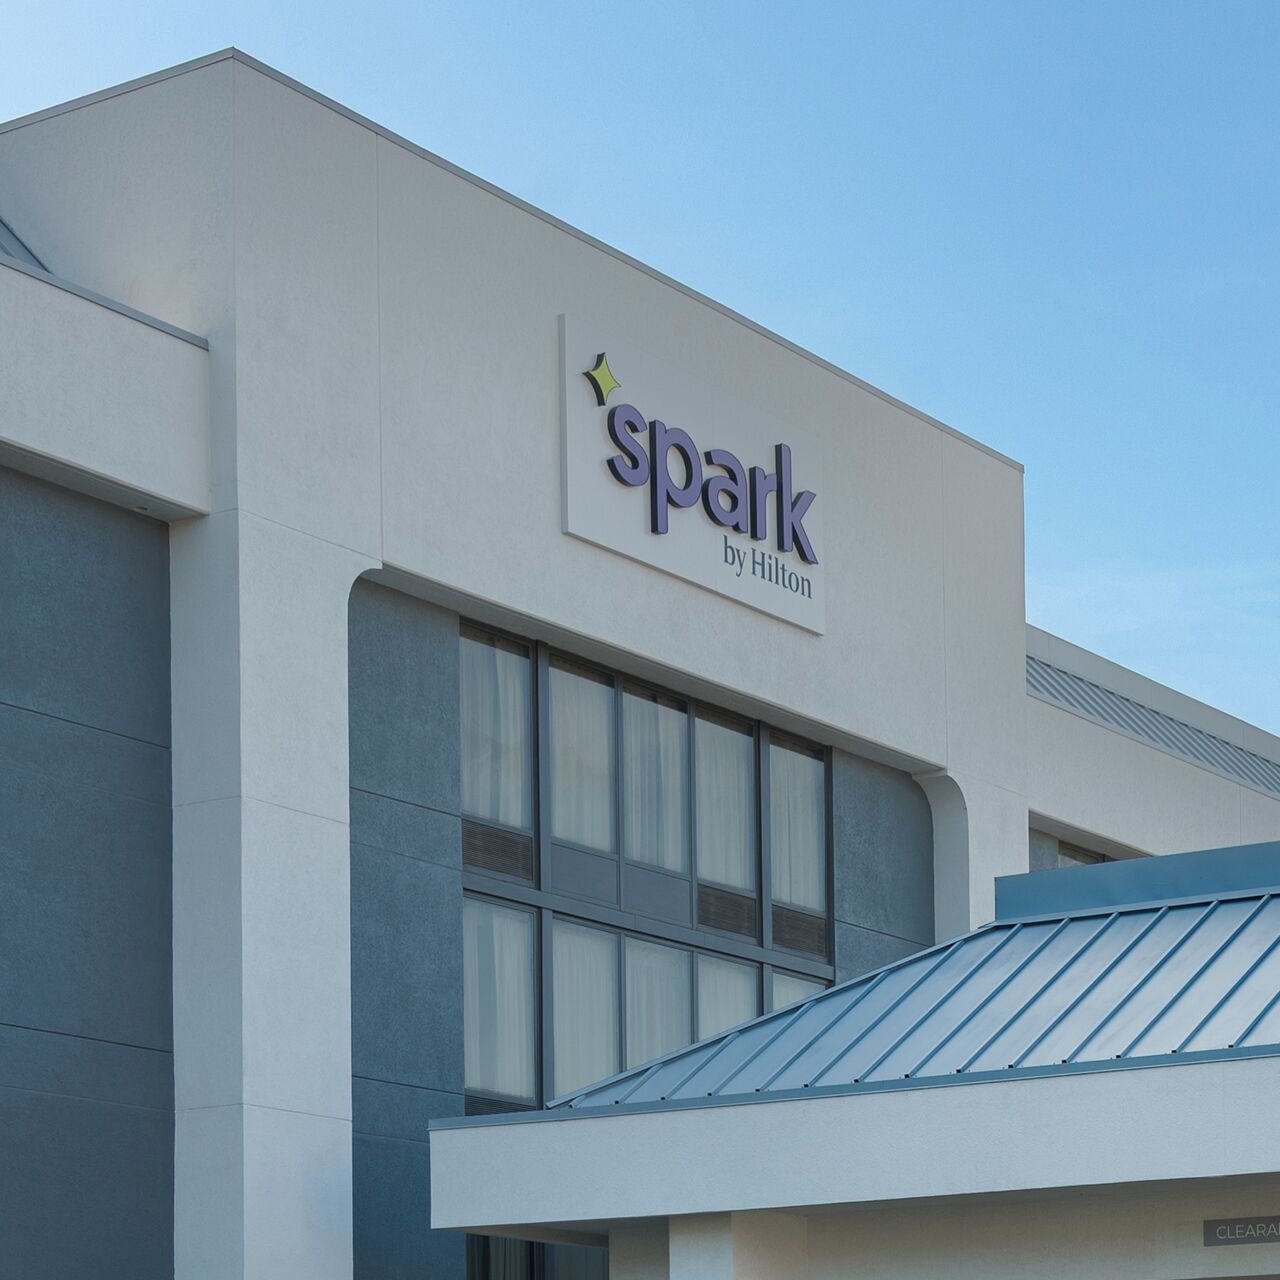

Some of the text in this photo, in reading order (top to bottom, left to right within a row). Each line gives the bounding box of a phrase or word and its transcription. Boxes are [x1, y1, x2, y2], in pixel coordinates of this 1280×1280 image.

[606, 403, 818, 565] spark
[723, 534, 812, 599] by Hilton
